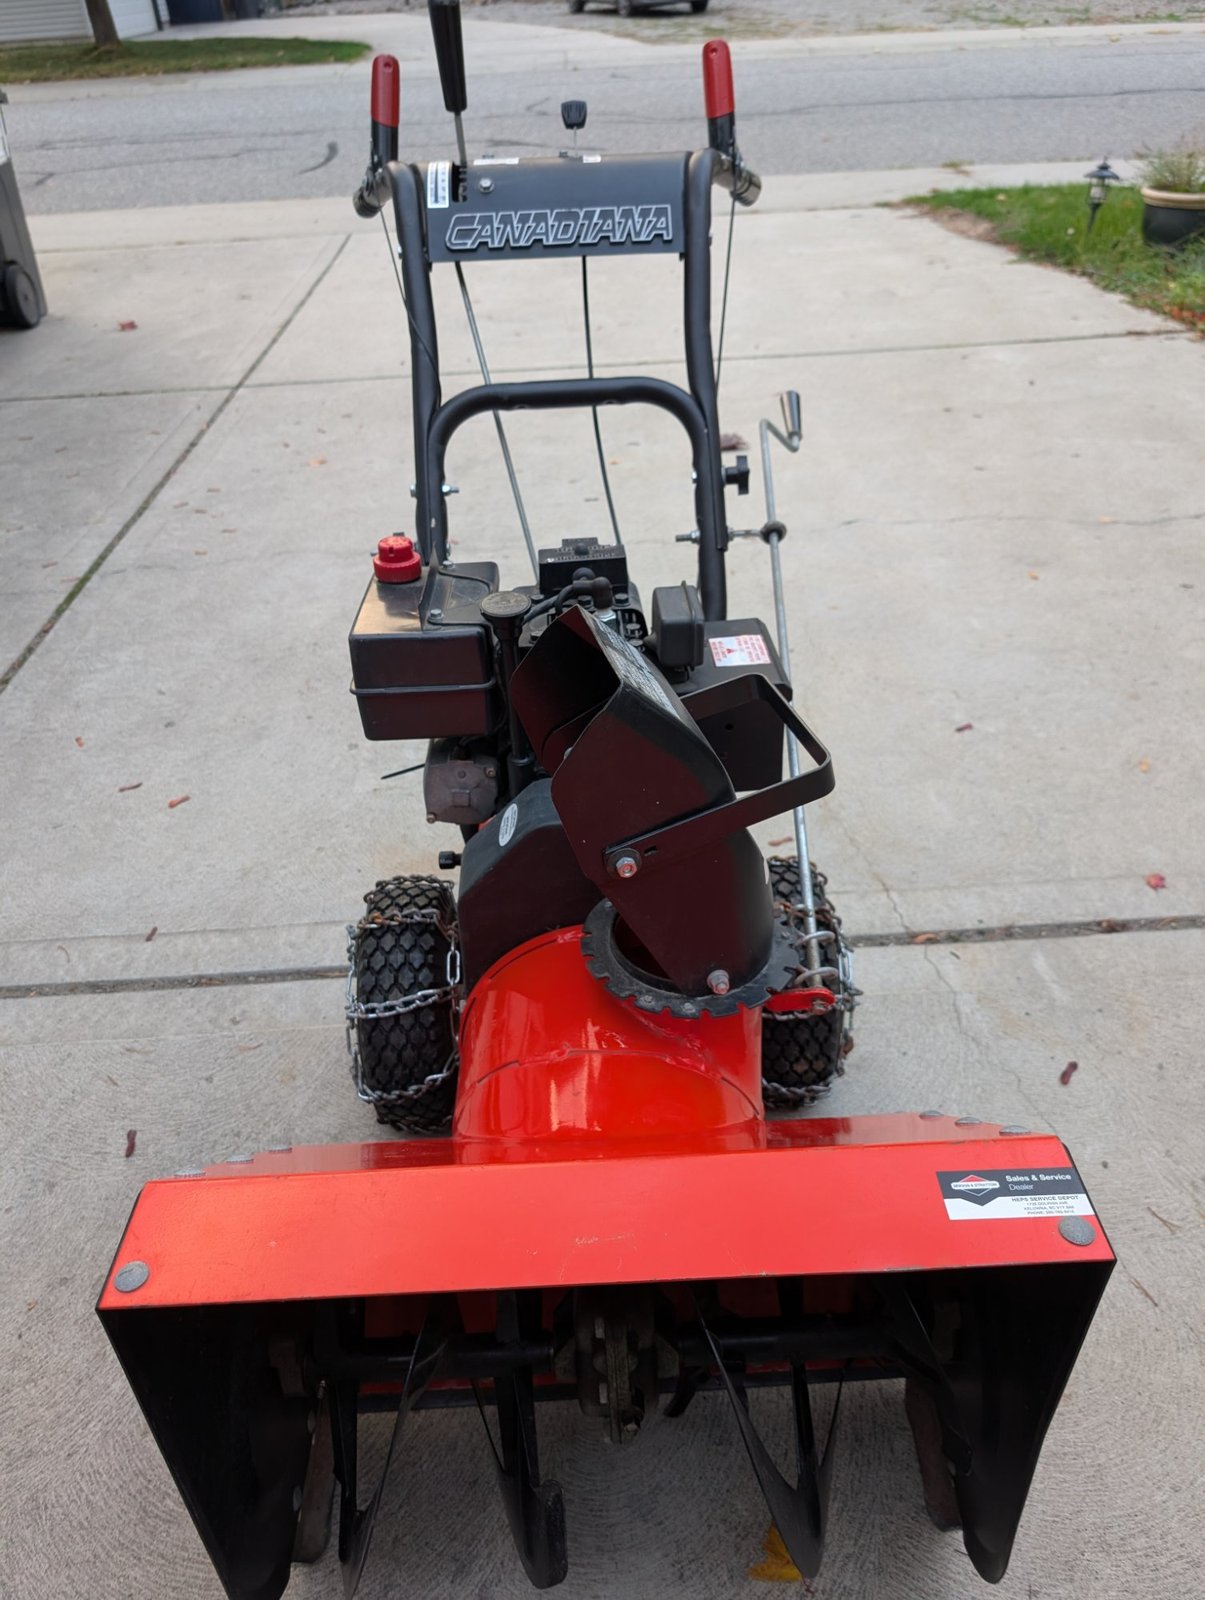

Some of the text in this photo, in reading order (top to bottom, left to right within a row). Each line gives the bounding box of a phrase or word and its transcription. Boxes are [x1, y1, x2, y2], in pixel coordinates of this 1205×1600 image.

[445, 204, 673, 249] CANADIANA
[1039, 1173, 1072, 1181] Service
[1008, 1183, 1034, 1191] Dealer
